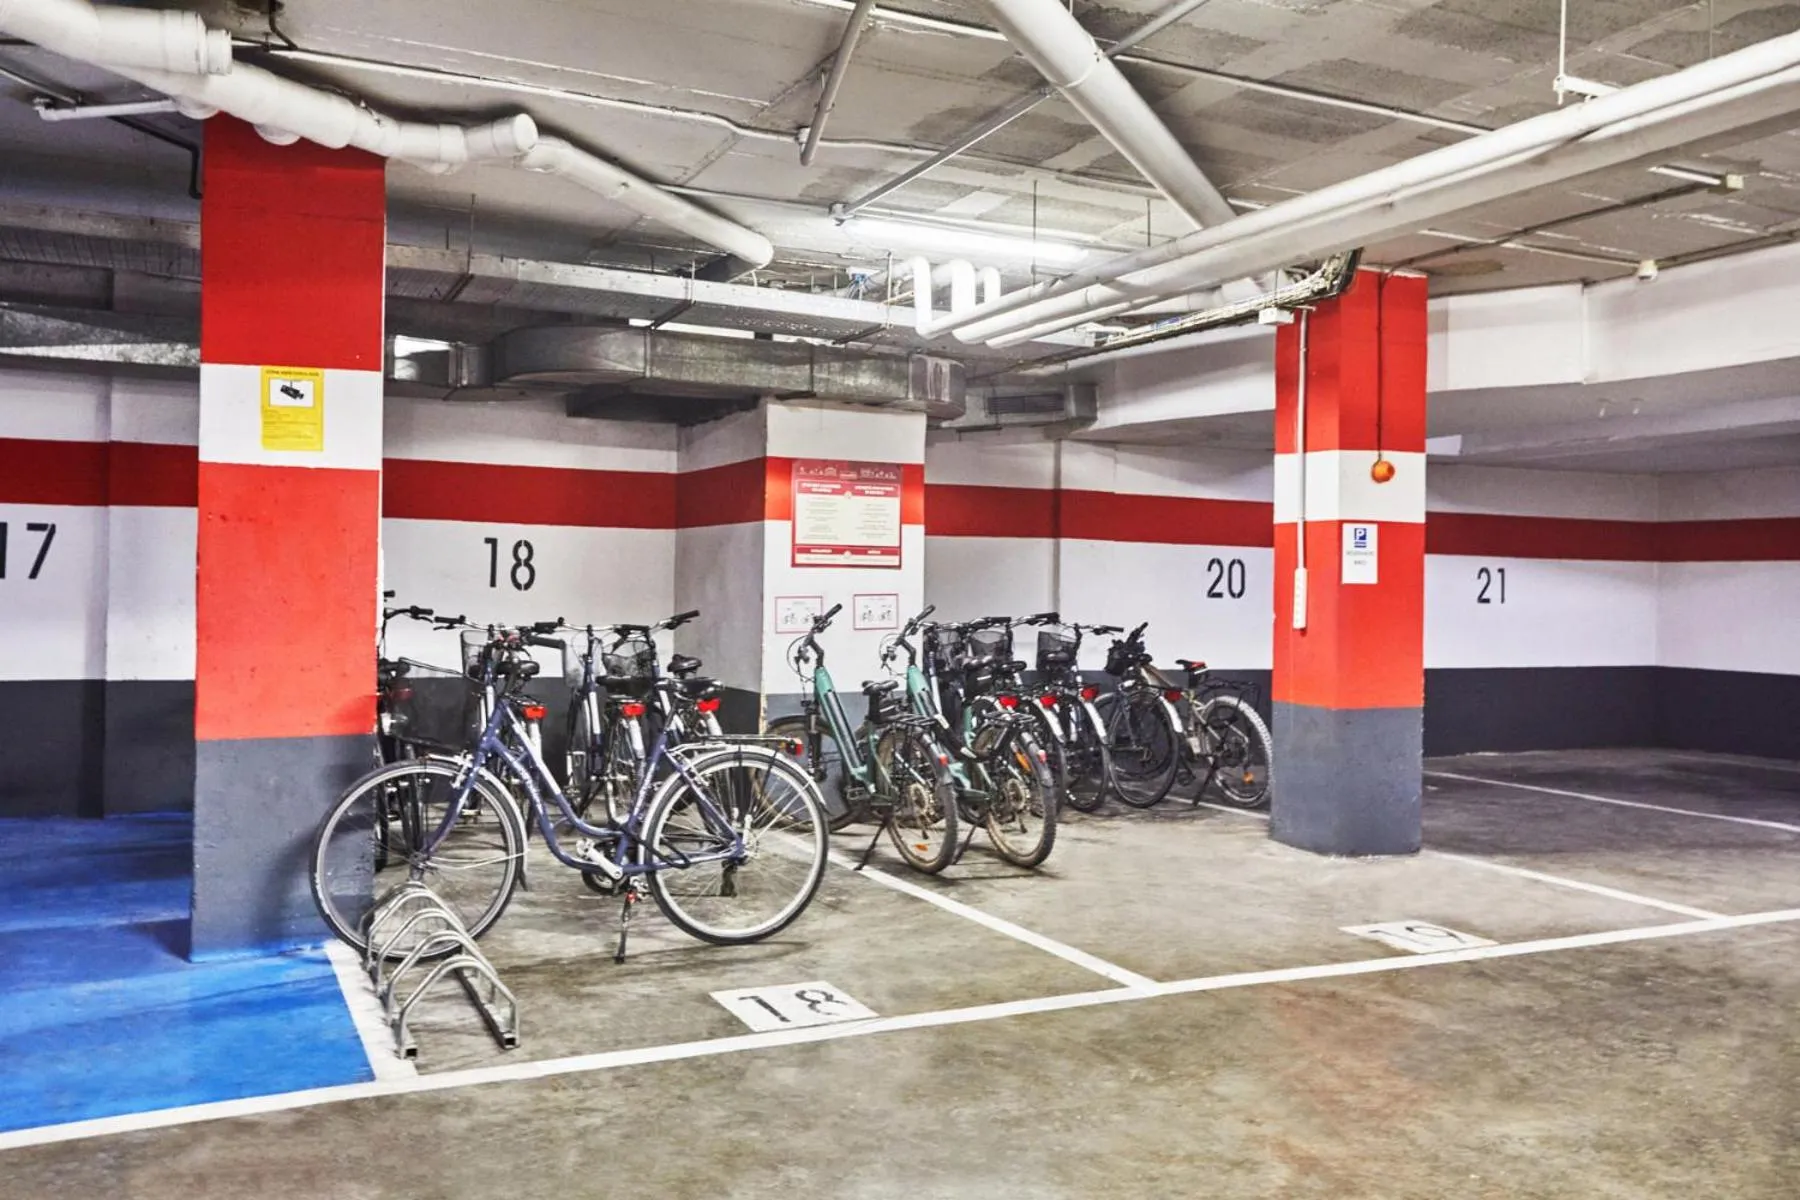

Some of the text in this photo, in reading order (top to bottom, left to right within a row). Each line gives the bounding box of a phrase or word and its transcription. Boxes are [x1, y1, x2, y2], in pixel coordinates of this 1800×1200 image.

[0, 522, 56, 579] 17
[484, 537, 536, 591] 18
[1207, 558, 1246, 599] 20
[1477, 567, 1505, 604] 21
[738, 989, 848, 1022] 18
